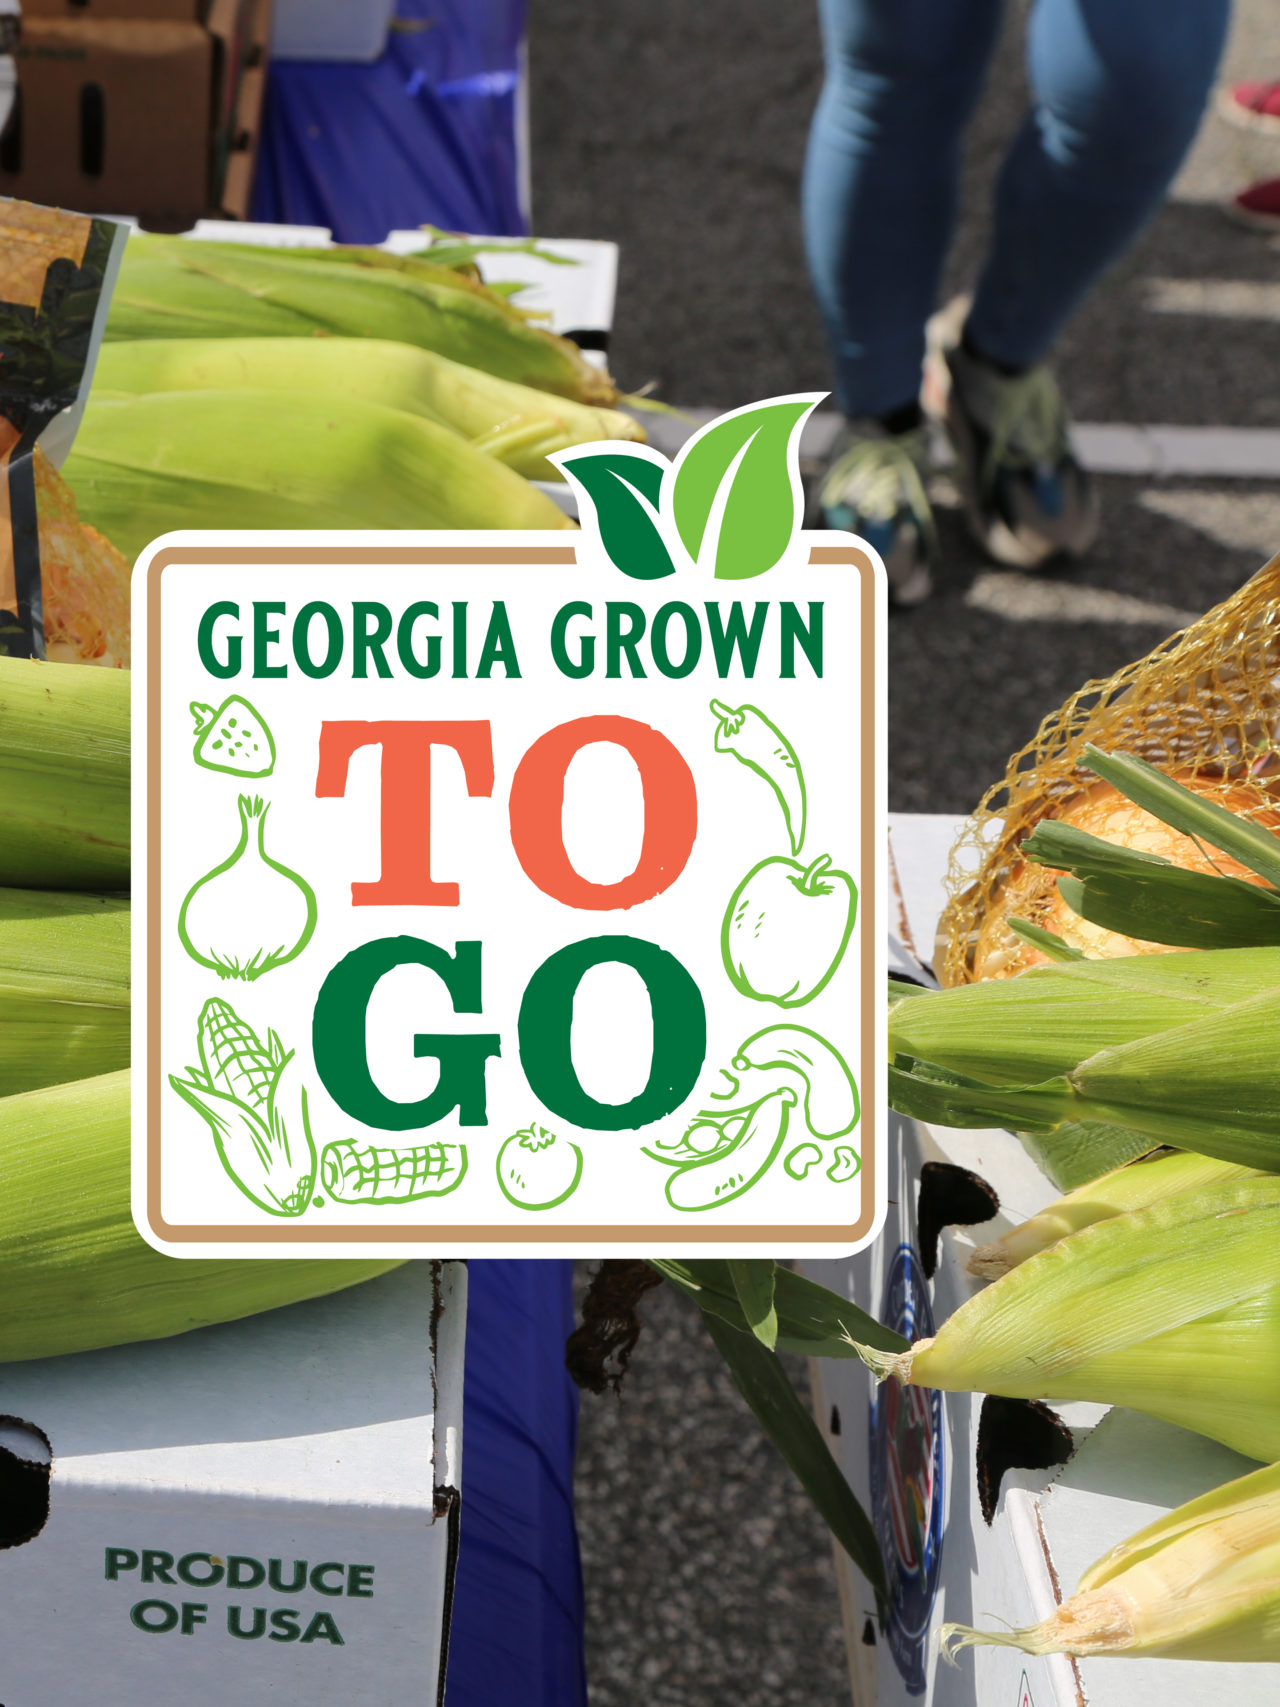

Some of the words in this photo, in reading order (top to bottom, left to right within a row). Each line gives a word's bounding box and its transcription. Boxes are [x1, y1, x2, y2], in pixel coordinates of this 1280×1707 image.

[104, 1546, 376, 1598] PRODUCE
[129, 1598, 209, 1636] OF
[226, 1605, 346, 1647] USA
